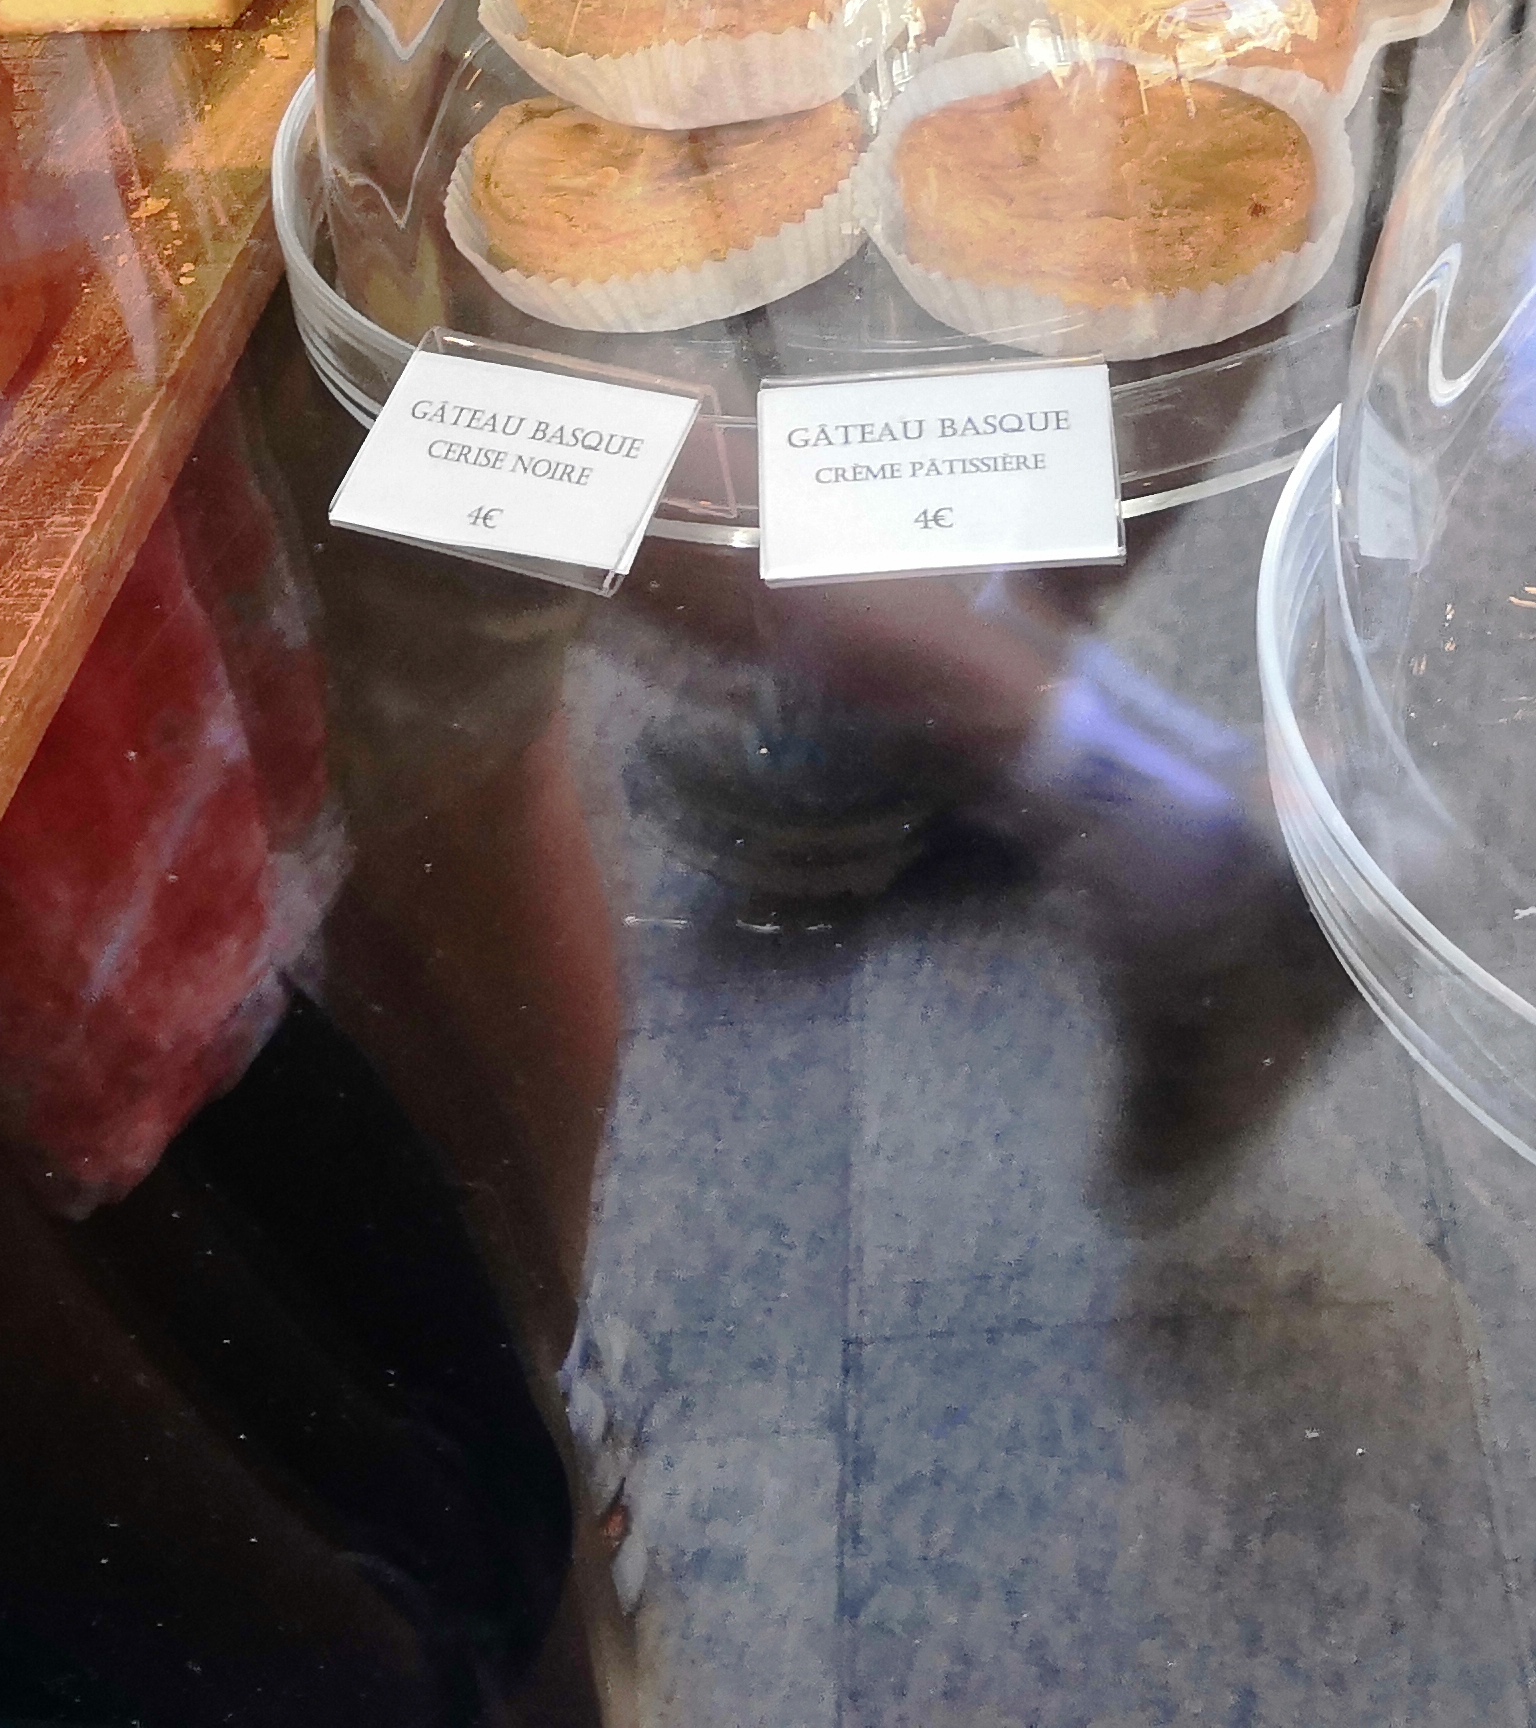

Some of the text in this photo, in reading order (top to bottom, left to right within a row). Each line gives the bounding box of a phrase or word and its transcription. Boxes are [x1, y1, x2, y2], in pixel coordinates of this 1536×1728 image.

[411, 400, 644, 459] GÂTEAU BASQUE
[787, 410, 1071, 449] GÂTEAU BASQUE
[428, 439, 594, 486] CERISE NOIRE
[815, 453, 1046, 485] CRÈME PÂTISSIÈRE
[467, 504, 504, 529] 4€
[914, 506, 954, 530] 4€
